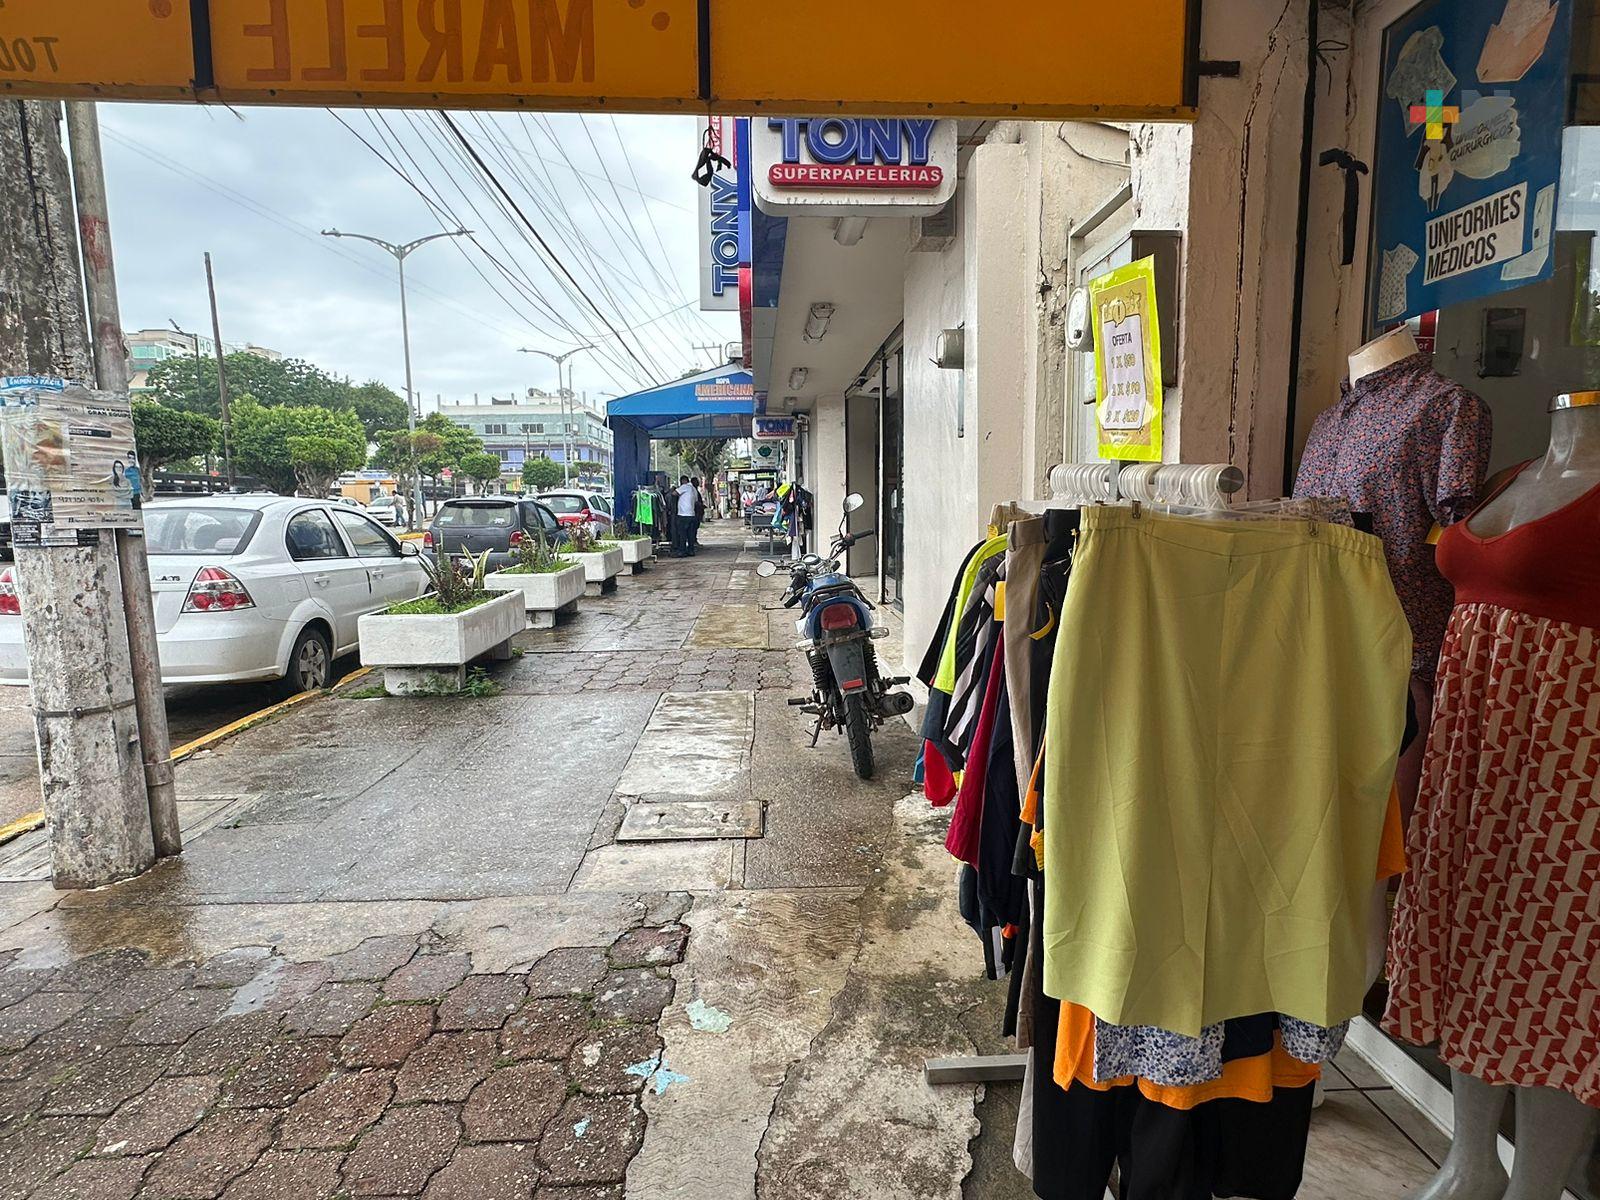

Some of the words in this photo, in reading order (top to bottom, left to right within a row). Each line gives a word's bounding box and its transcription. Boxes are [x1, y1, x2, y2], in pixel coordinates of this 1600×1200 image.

[768, 117, 936, 165] TONY
[772, 167, 942, 182] SUPERPAPELERIAS
[711, 173, 738, 296] TONY
[1428, 189, 1521, 250] UNIFORMES
[1426, 233, 1497, 281] MÉDICOS
[1112, 333, 1132, 346] OFERTA
[695, 384, 753, 397] AMERICANA
[756, 419, 794, 433] TONY
